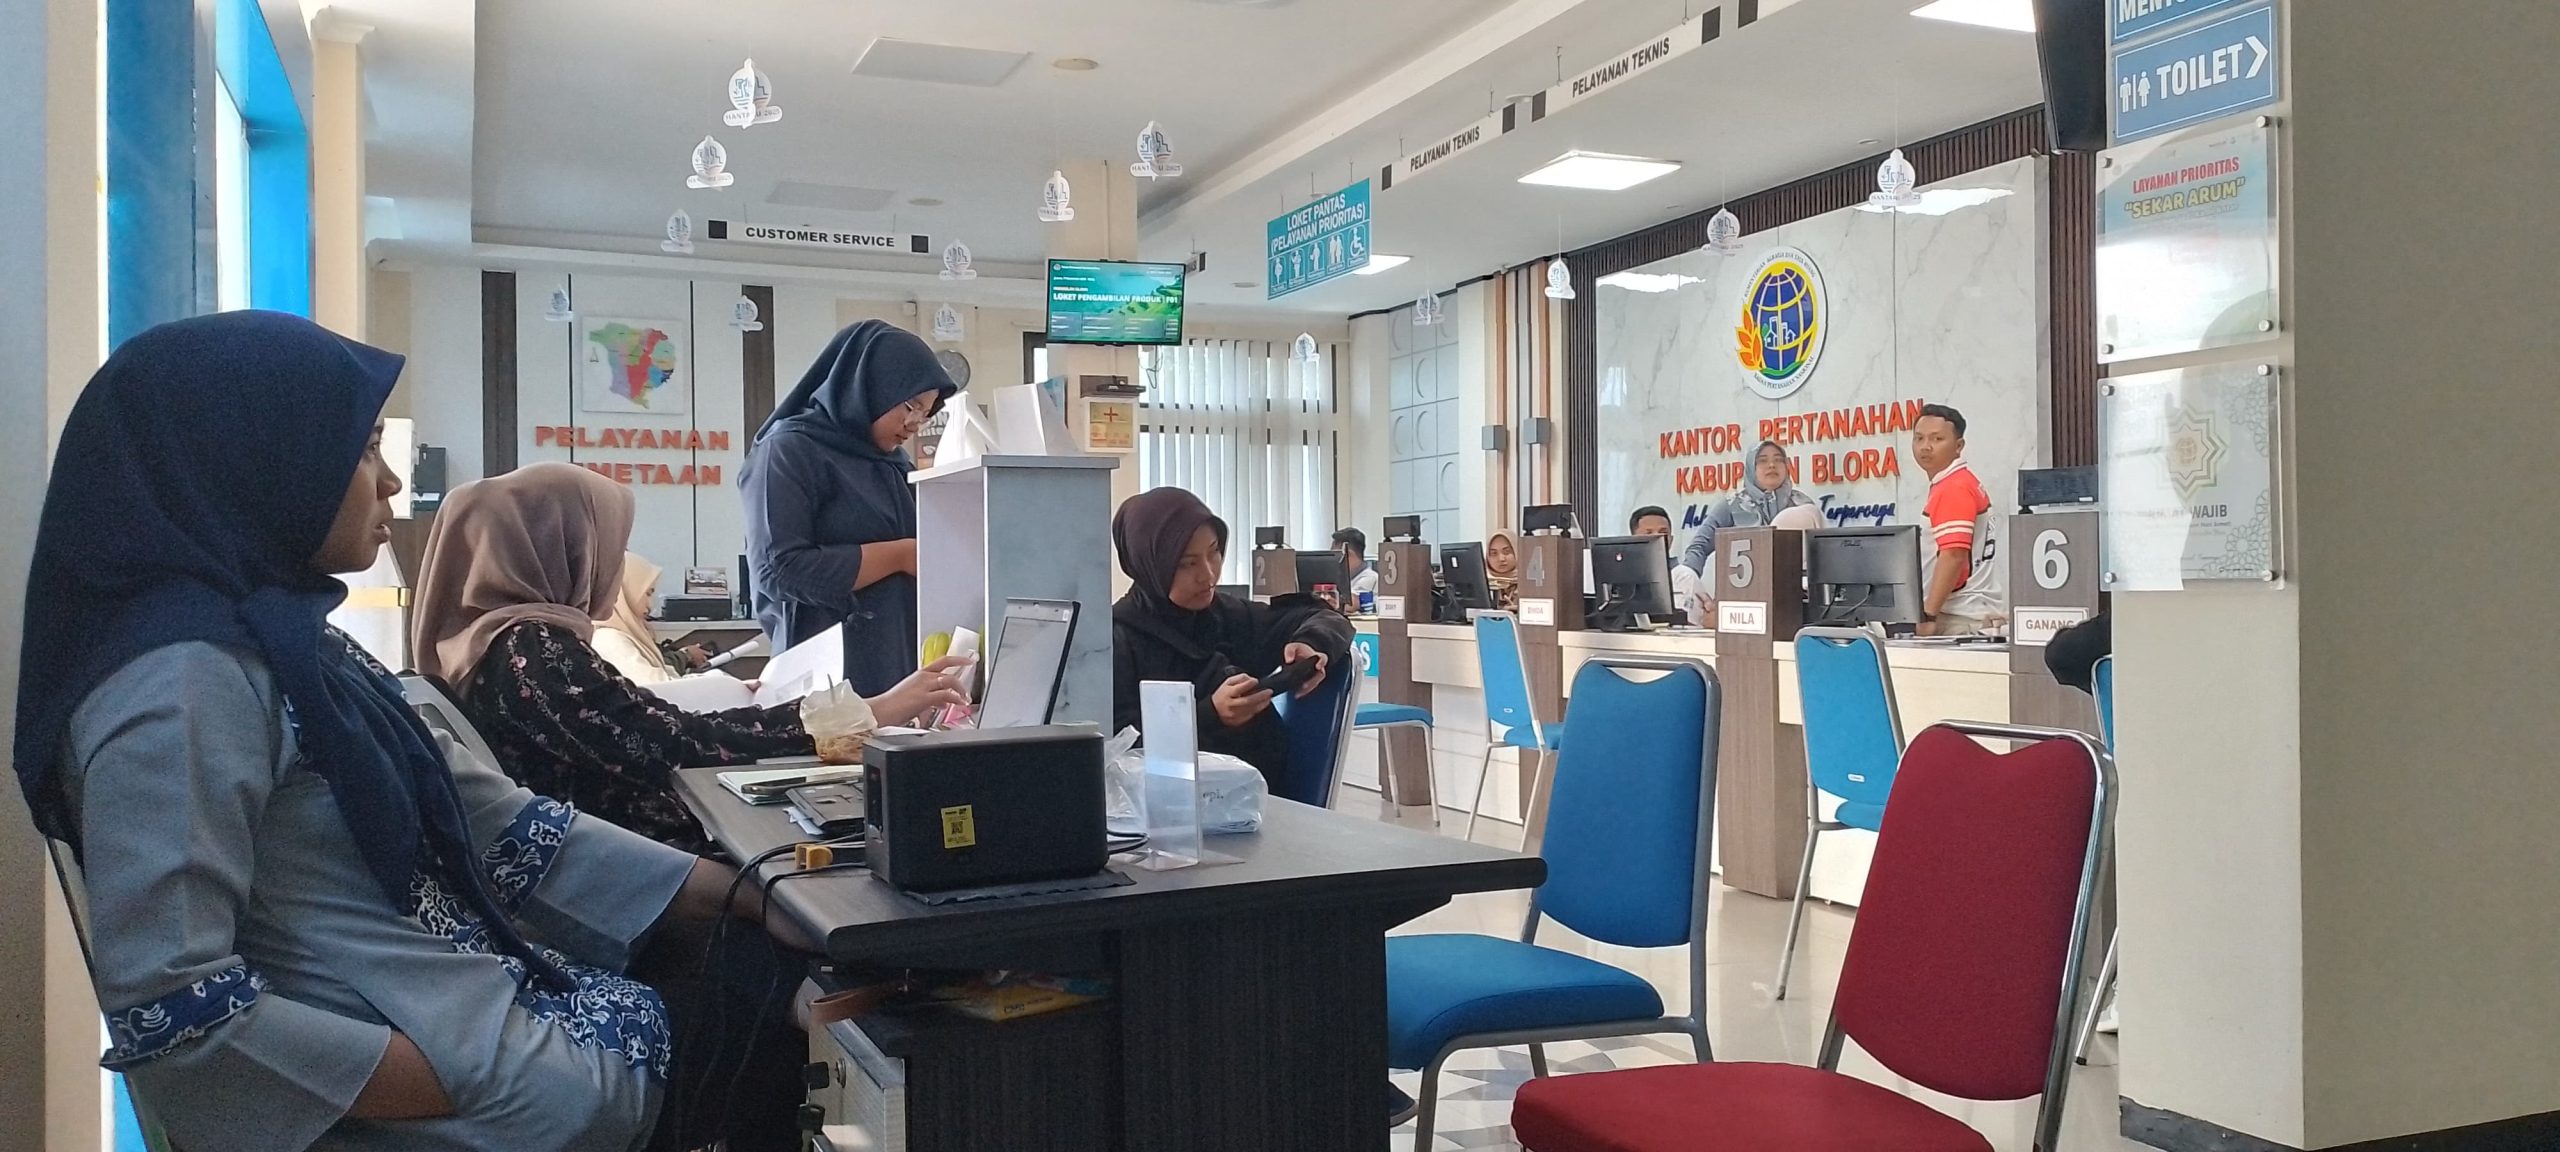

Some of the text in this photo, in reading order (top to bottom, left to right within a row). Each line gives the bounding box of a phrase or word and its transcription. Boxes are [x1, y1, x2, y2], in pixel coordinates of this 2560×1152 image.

[1572, 37, 1670, 98] PELAYANAN TEKNIS
[2156, 43, 2243, 100] TOILET
[1410, 126, 1480, 173] PELAYANAN TEKNIS
[2133, 156, 2240, 194] LAYANAN PRIORITAS
[1271, 202, 1366, 257] (PELAYANAN PRIORITAS)
[1287, 194, 1346, 231] LOKET PANTAS
[745, 227, 895, 247] CUSTOMER SERVICE
[1053, 293, 1077, 301] LOKET
[1078, 294, 1131, 302] PENGAMBILAN
[1132, 295, 1161, 303] PRODUK
[535, 426, 730, 450] PELAYANAN
[1660, 398, 1924, 459] KANTOR PERTANAHAN
[1676, 447, 1901, 493] KABUPN BLORA
[2190, 504, 2228, 518] WAJIB
[1256, 556, 1266, 586] 2
[1384, 550, 1398, 585] 3
[1526, 546, 1545, 587] 4
[1728, 539, 1754, 588] 5
[2032, 529, 2071, 590] 6
[1729, 612, 1755, 625] NILA
